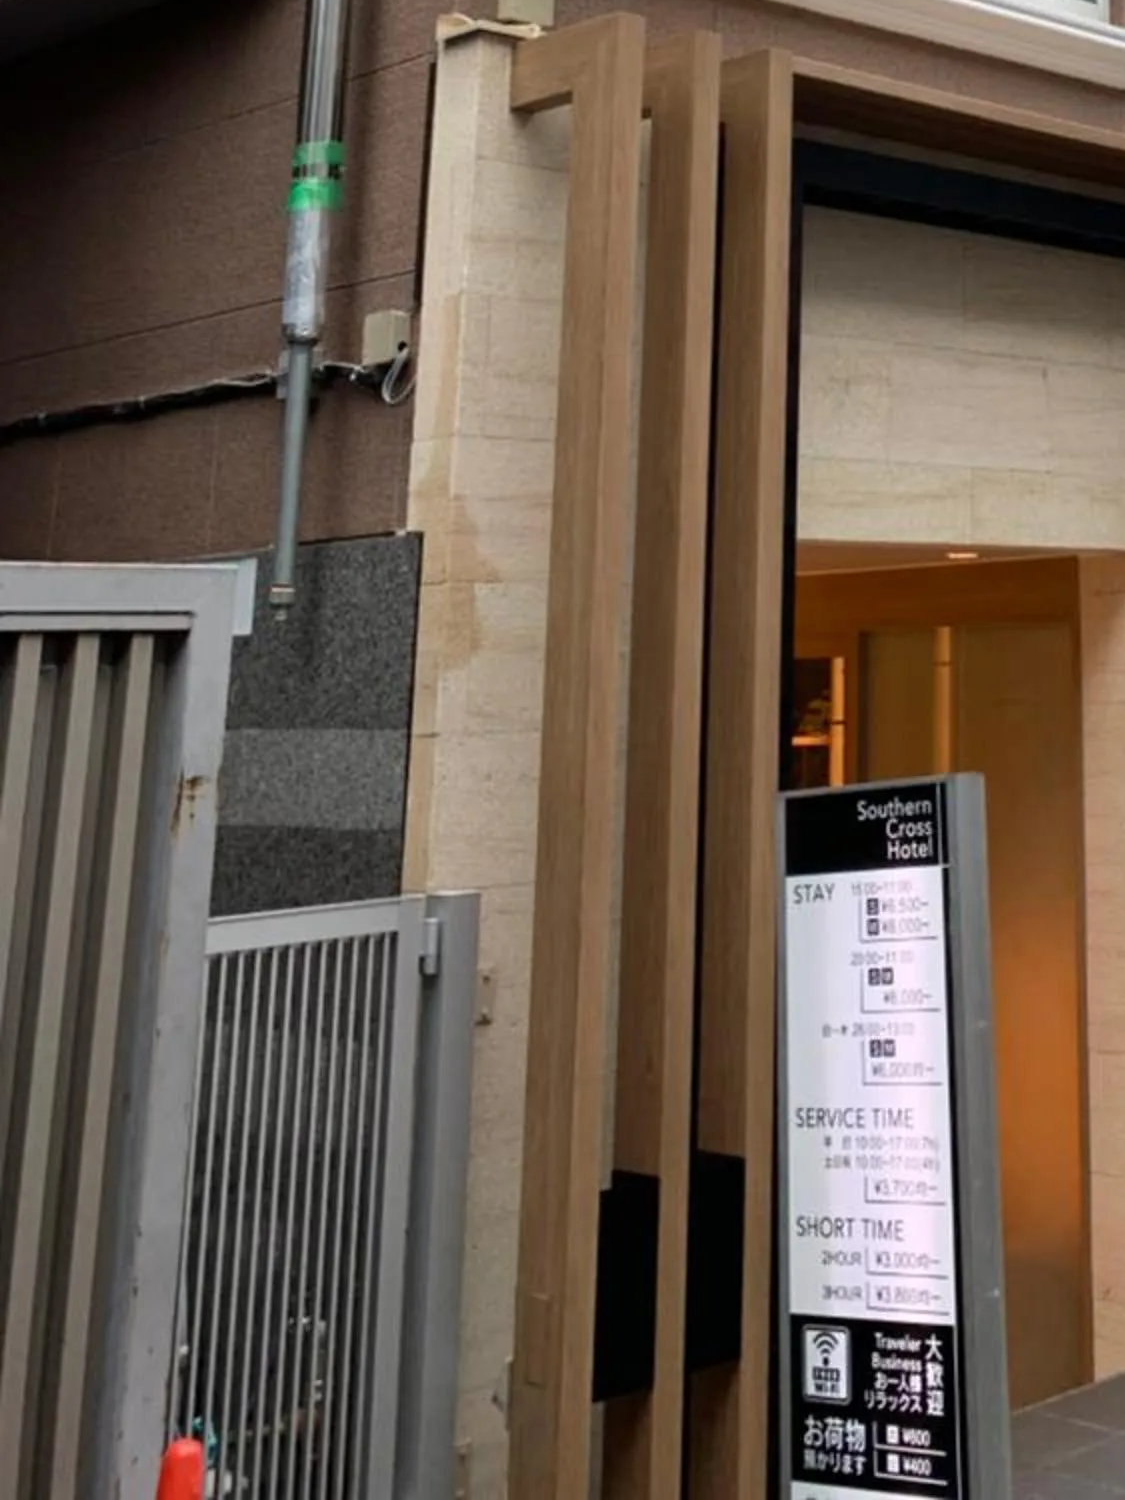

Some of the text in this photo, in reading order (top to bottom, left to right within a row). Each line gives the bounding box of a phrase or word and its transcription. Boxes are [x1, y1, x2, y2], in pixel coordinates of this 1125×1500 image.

[856, 796, 933, 821] Southern
[885, 818, 933, 840] Cross
[886, 836, 933, 860] Hotel
[793, 882, 835, 904] STAY
[795, 1107, 915, 1129] SERVICE TIME
[796, 1214, 904, 1242] SHORT TIME
[874, 1332, 922, 1352] Traveler
[871, 1352, 922, 1373] Business
[925, 1333, 945, 1417] 大歓迎
[864, 1390, 923, 1414] リラックス
[803, 1415, 867, 1453] お荷物
